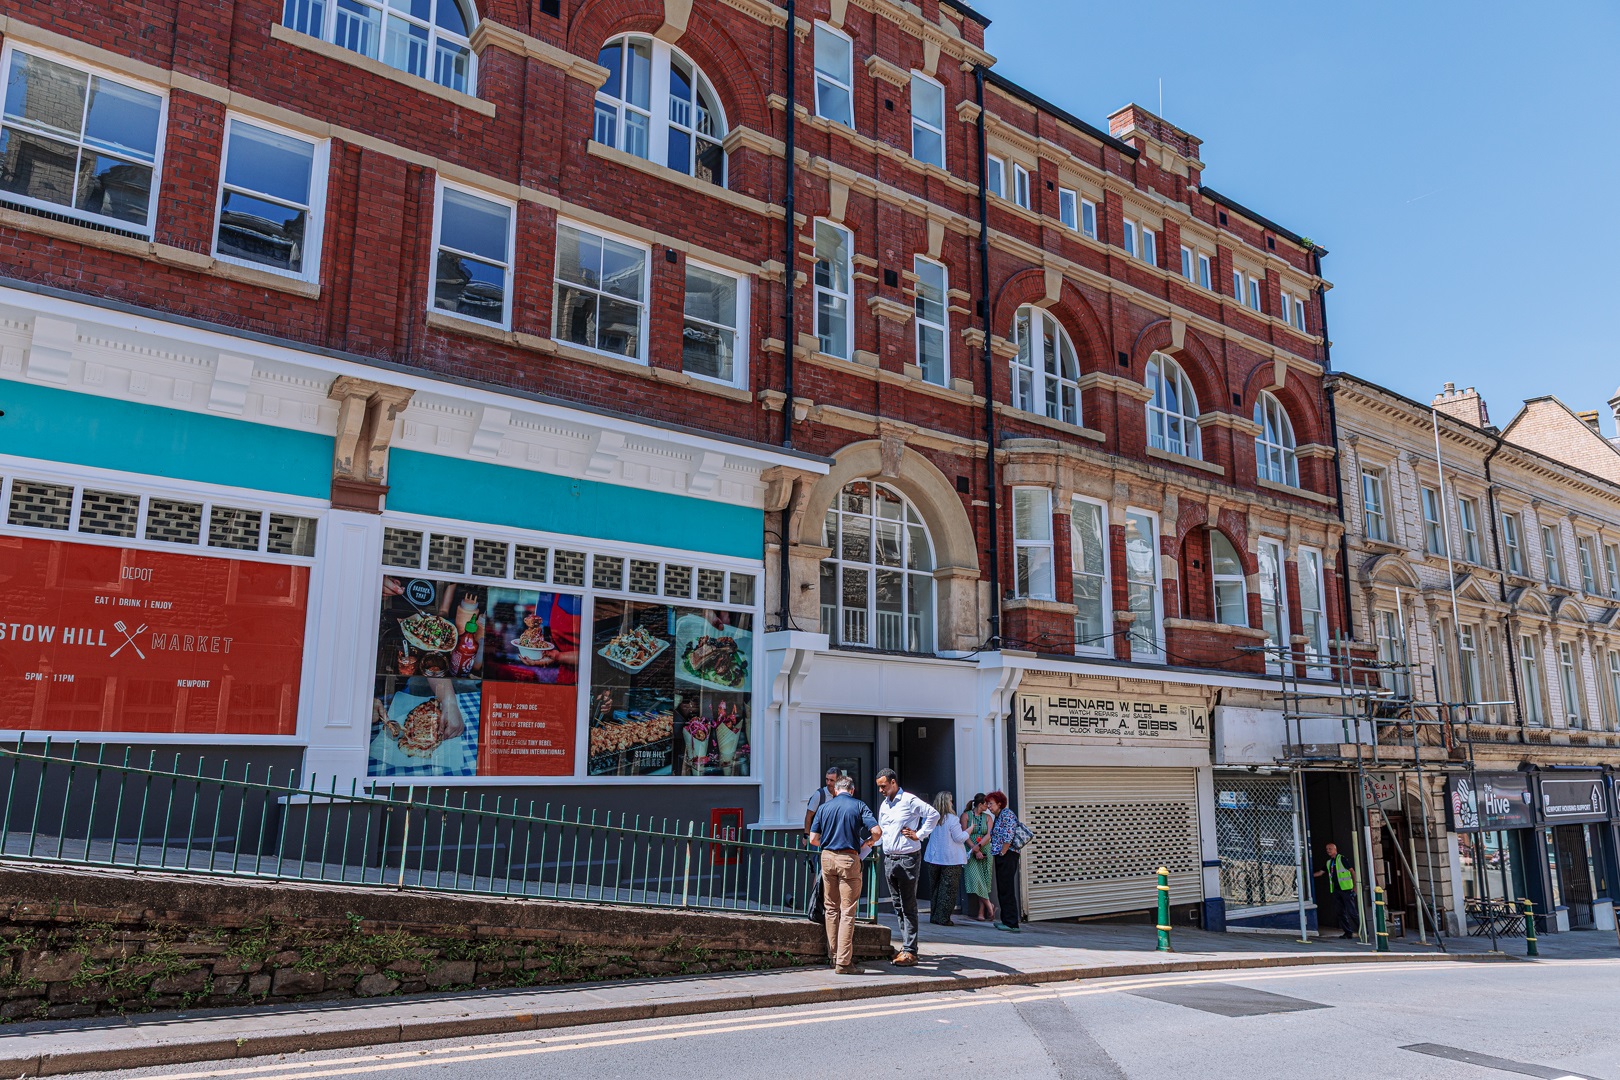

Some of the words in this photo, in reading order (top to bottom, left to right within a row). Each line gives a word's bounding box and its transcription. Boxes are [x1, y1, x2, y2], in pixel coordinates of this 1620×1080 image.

[121, 566, 153, 582] DEPOT
[94, 595, 109, 605] EAT
[118, 598, 141, 607] DRINK
[150, 601, 173, 610] ENJOY
[0, 622, 56, 643] STOW
[62, 627, 107, 647] HILL
[151, 632, 233, 654] MARKET
[25, 672, 43, 681] 5PM
[53, 674, 75, 683] 11PM
[177, 679, 210, 688] NEWPORT
[1023, 698, 1037, 726] 14
[1048, 697, 1114, 711] LEONARD
[1119, 701, 1130, 712] W.
[1133, 703, 1168, 714] COLE
[1048, 715, 1109, 728] ROBERT
[1118, 718, 1130, 729] A.
[1137, 720, 1178, 731] GIBBS
[1191, 709, 1205, 734] 14
[1094, 728, 1121, 736] REPAIRS
[1363, 781, 1395, 791] BEAK
[1483, 783, 1492, 792] the
[1484, 793, 1511, 814] Hive
